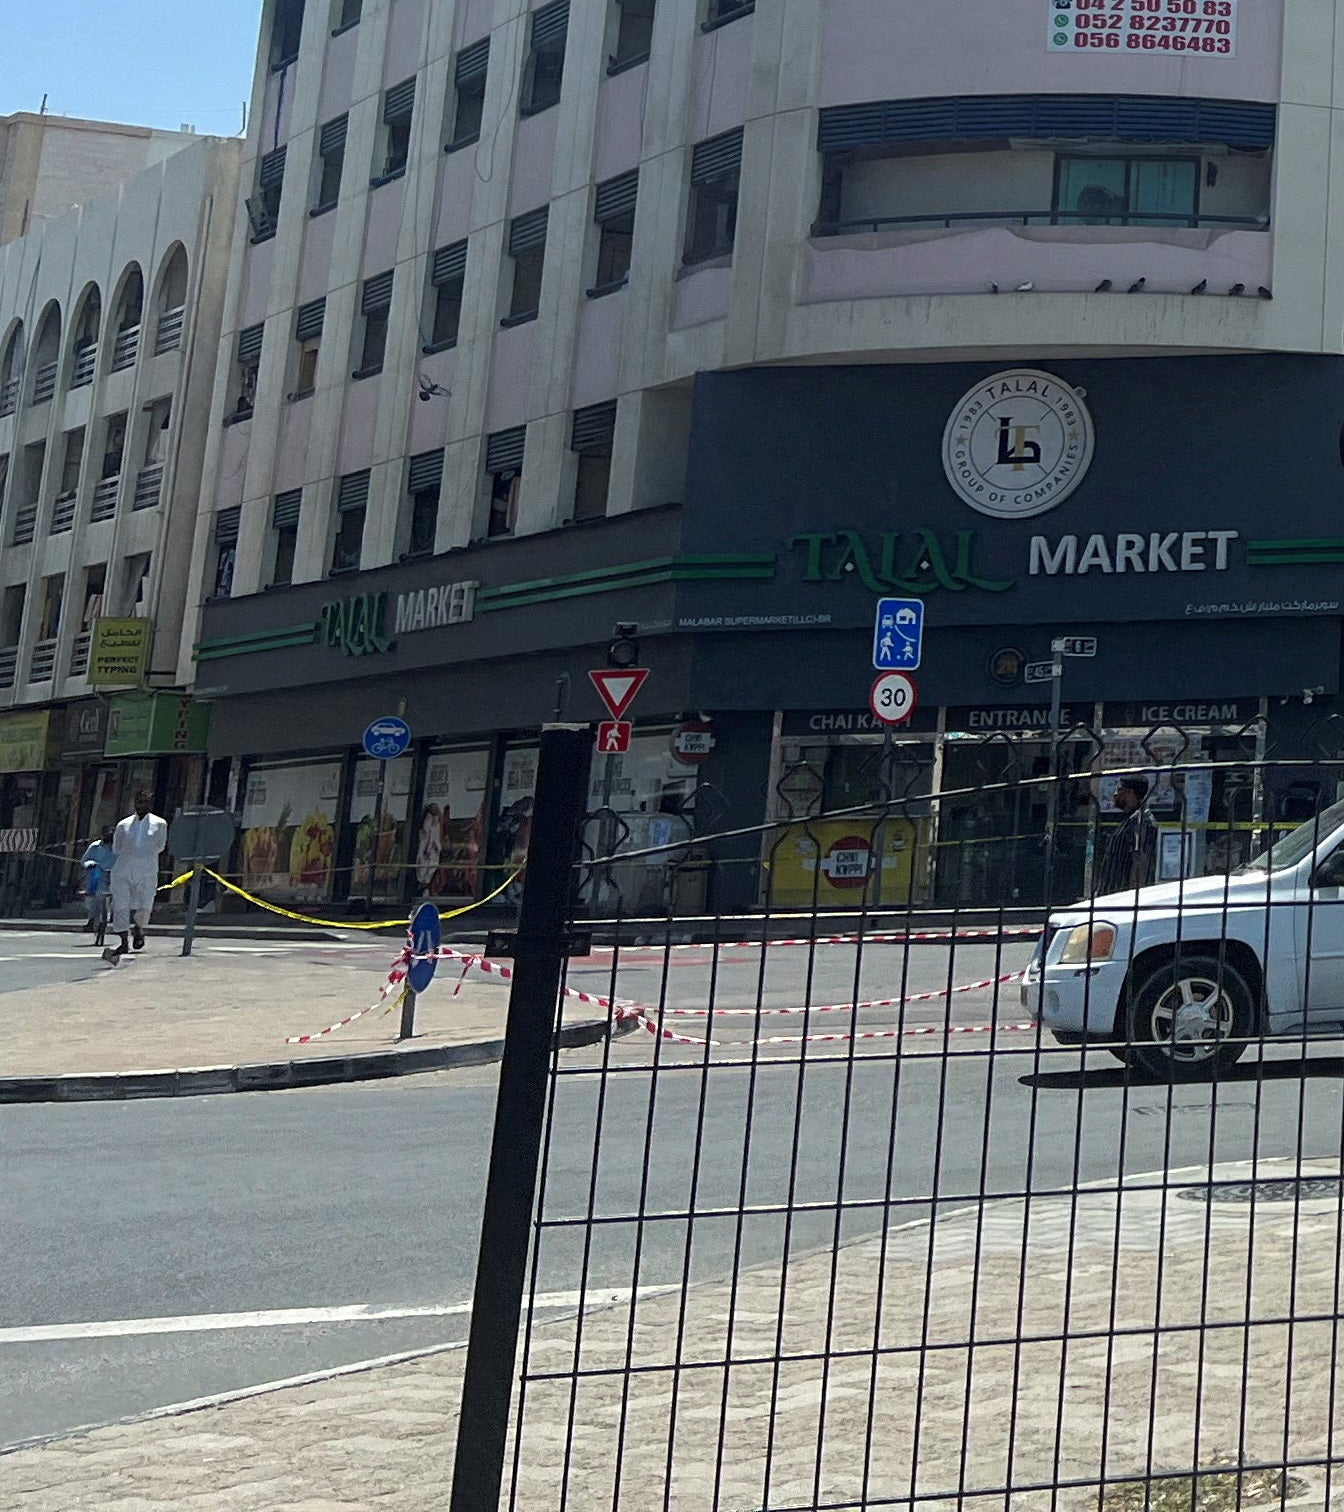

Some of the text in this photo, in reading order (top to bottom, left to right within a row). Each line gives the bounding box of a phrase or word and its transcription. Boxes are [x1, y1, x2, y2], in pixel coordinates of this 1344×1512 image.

[1203, 0, 1232, 16] 83
[1075, 14, 1231, 35] 052 8237770
[1074, 32, 1231, 53] 056 8646483
[959, 379, 1078, 430] 1983 TALAL 1983
[955, 444, 1079, 505] GROUP OF COMPANIES
[786, 527, 1239, 596] TALAL MARKET
[395, 580, 480, 634] MARKET
[679, 616, 722, 627] MALABAR
[97, 665, 137, 674] TYPING
[98, 656, 139, 664] PERFECT
[881, 688, 906, 707] 30
[809, 714, 853, 730] CHAI
[1142, 704, 1238, 722] ICE CREAM
